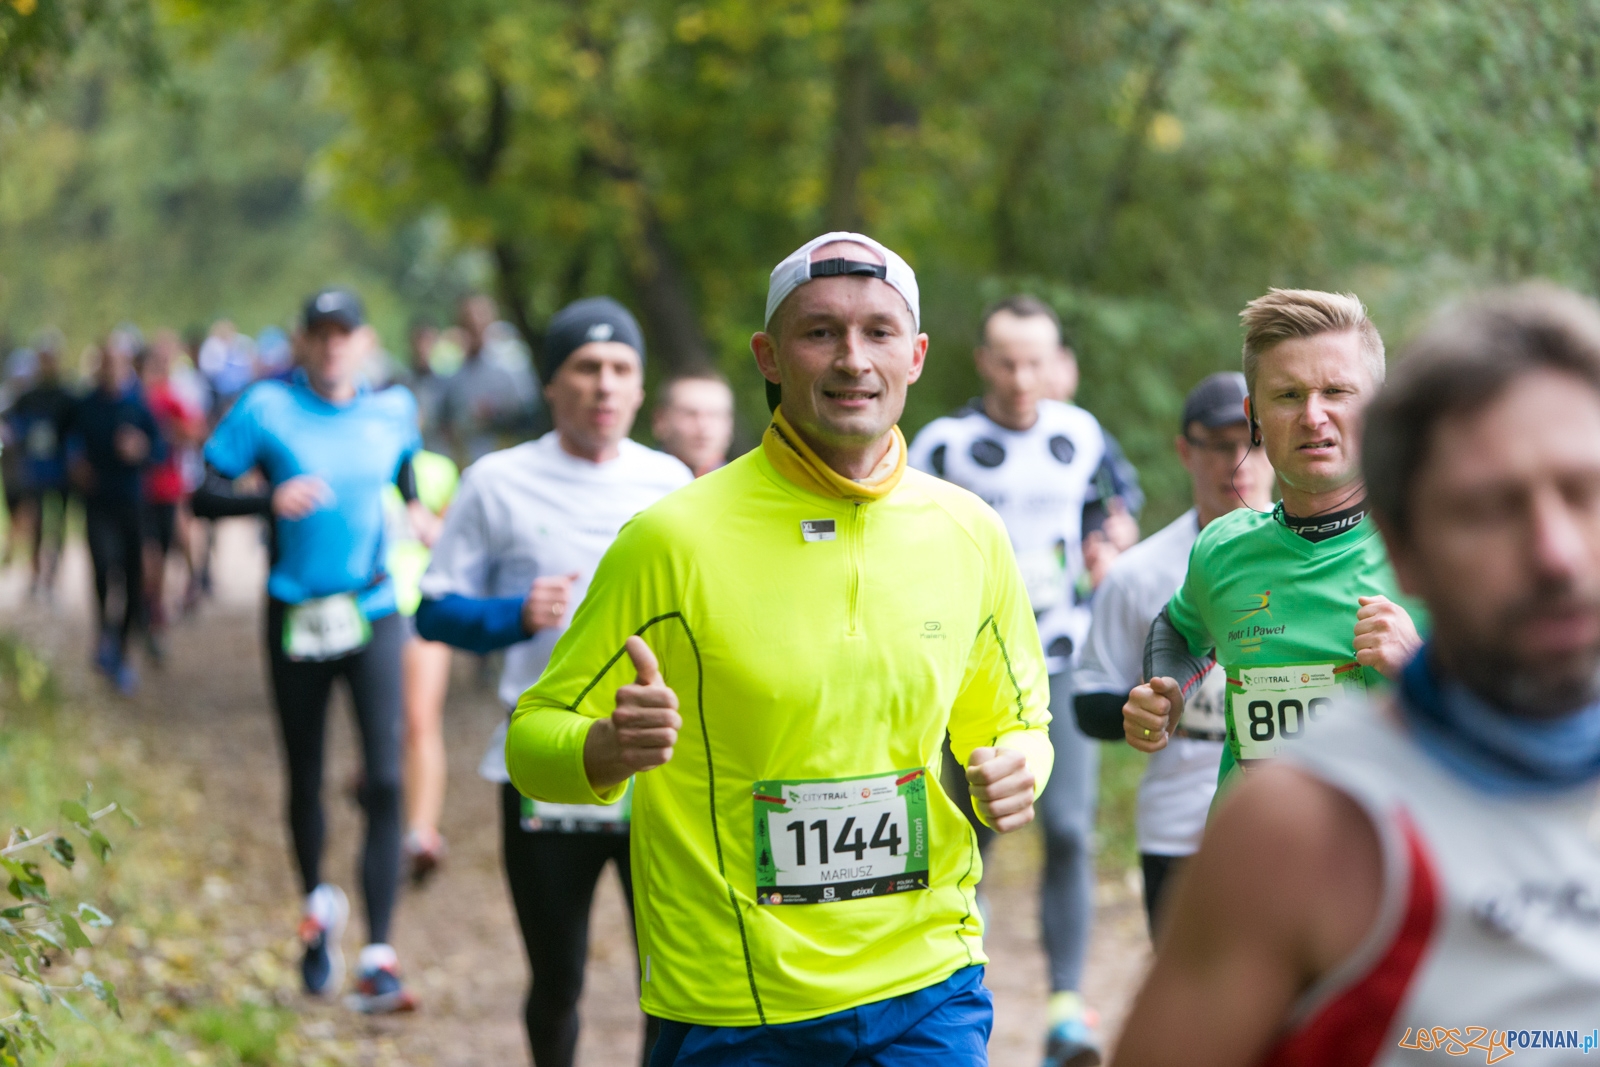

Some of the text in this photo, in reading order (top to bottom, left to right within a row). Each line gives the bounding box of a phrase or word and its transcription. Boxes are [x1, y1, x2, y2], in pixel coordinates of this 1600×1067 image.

[803, 522, 816, 531] XL
[1228, 630, 1244, 642] Piotr
[1253, 625, 1286, 636] Paweł
[787, 812, 901, 866] 1144
[913, 818, 923, 858] Poznań
[821, 865, 872, 881] MARIUSZ
